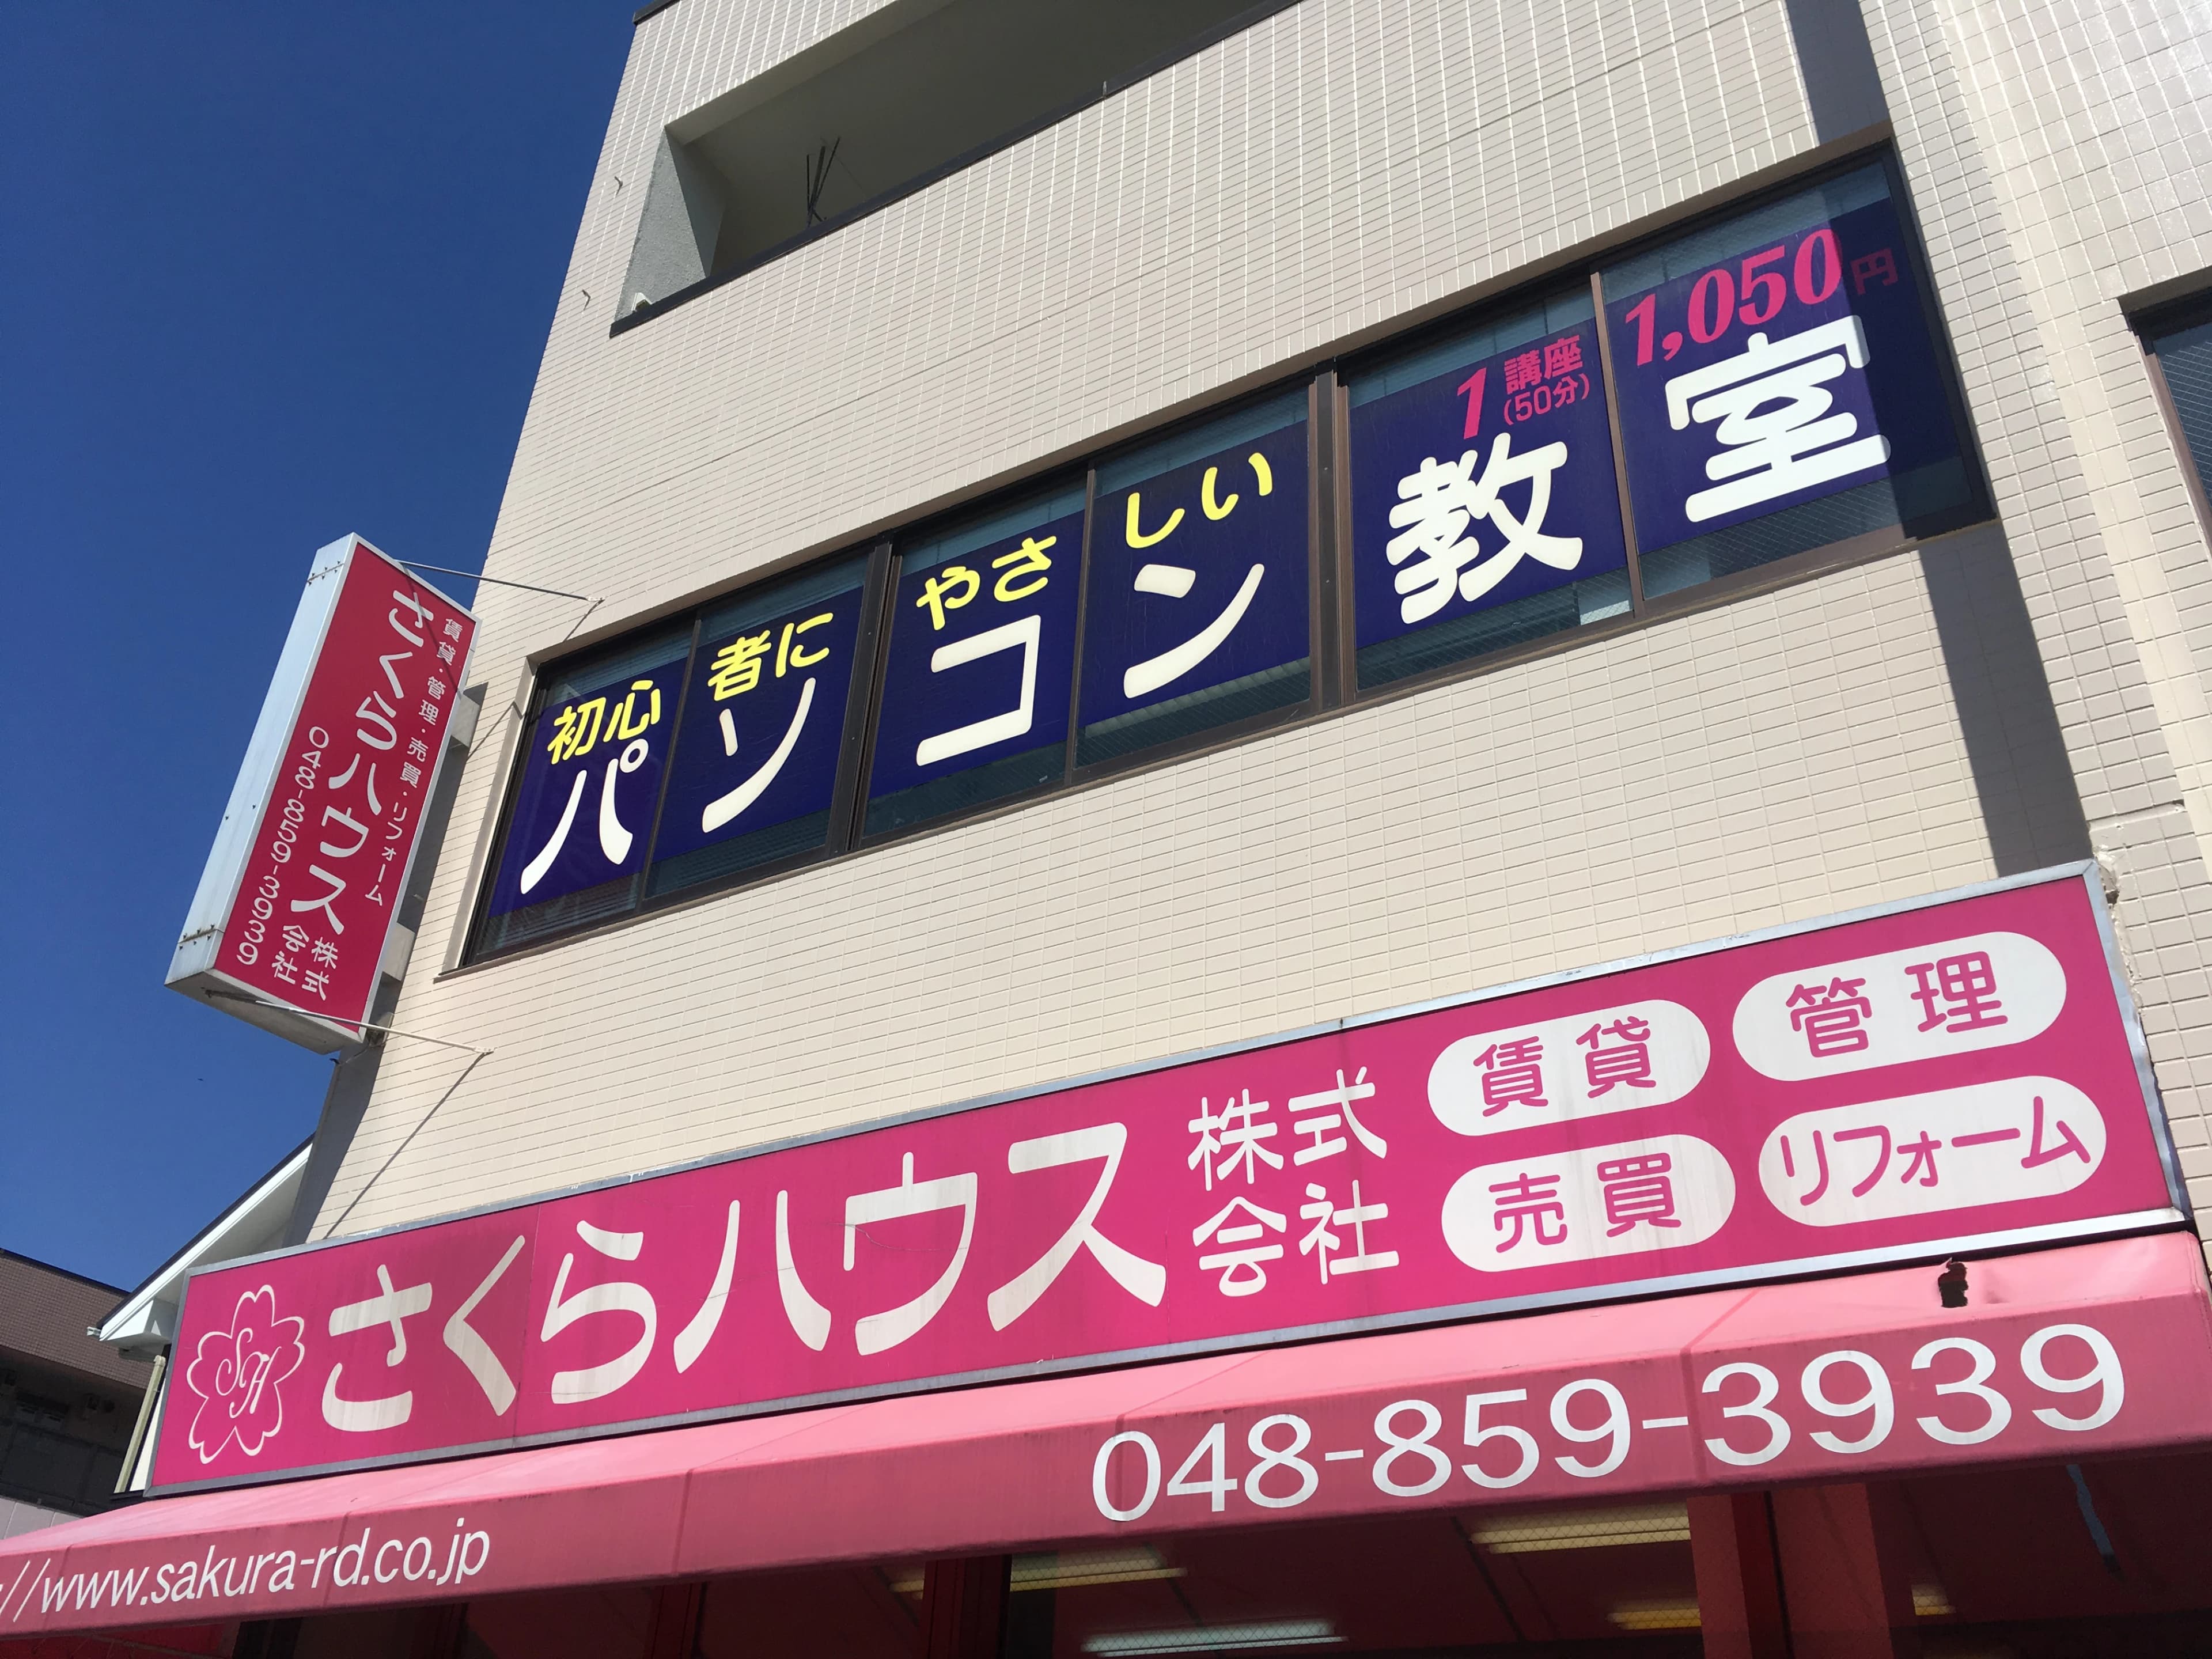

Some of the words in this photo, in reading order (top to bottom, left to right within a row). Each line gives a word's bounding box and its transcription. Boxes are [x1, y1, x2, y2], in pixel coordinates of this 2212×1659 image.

[1503, 373, 1590, 426] (50分)
[290, 590, 434, 935] さくらハウス
[236, 726, 329, 965] 048-859-3939
[1785, 950, 2009, 1059] 管理
[1472, 1016, 1657, 1118] 賃貸
[1487, 1152, 1682, 1254] 売買
[1780, 1096, 2092, 1207] リフォーム
[321, 1122, 1166, 1433] さくらハウス
[1092, 1323, 2126, 1521] 048-859-3939
[0, 1517, 490, 1623] //www.sakura-rd.co.jp
